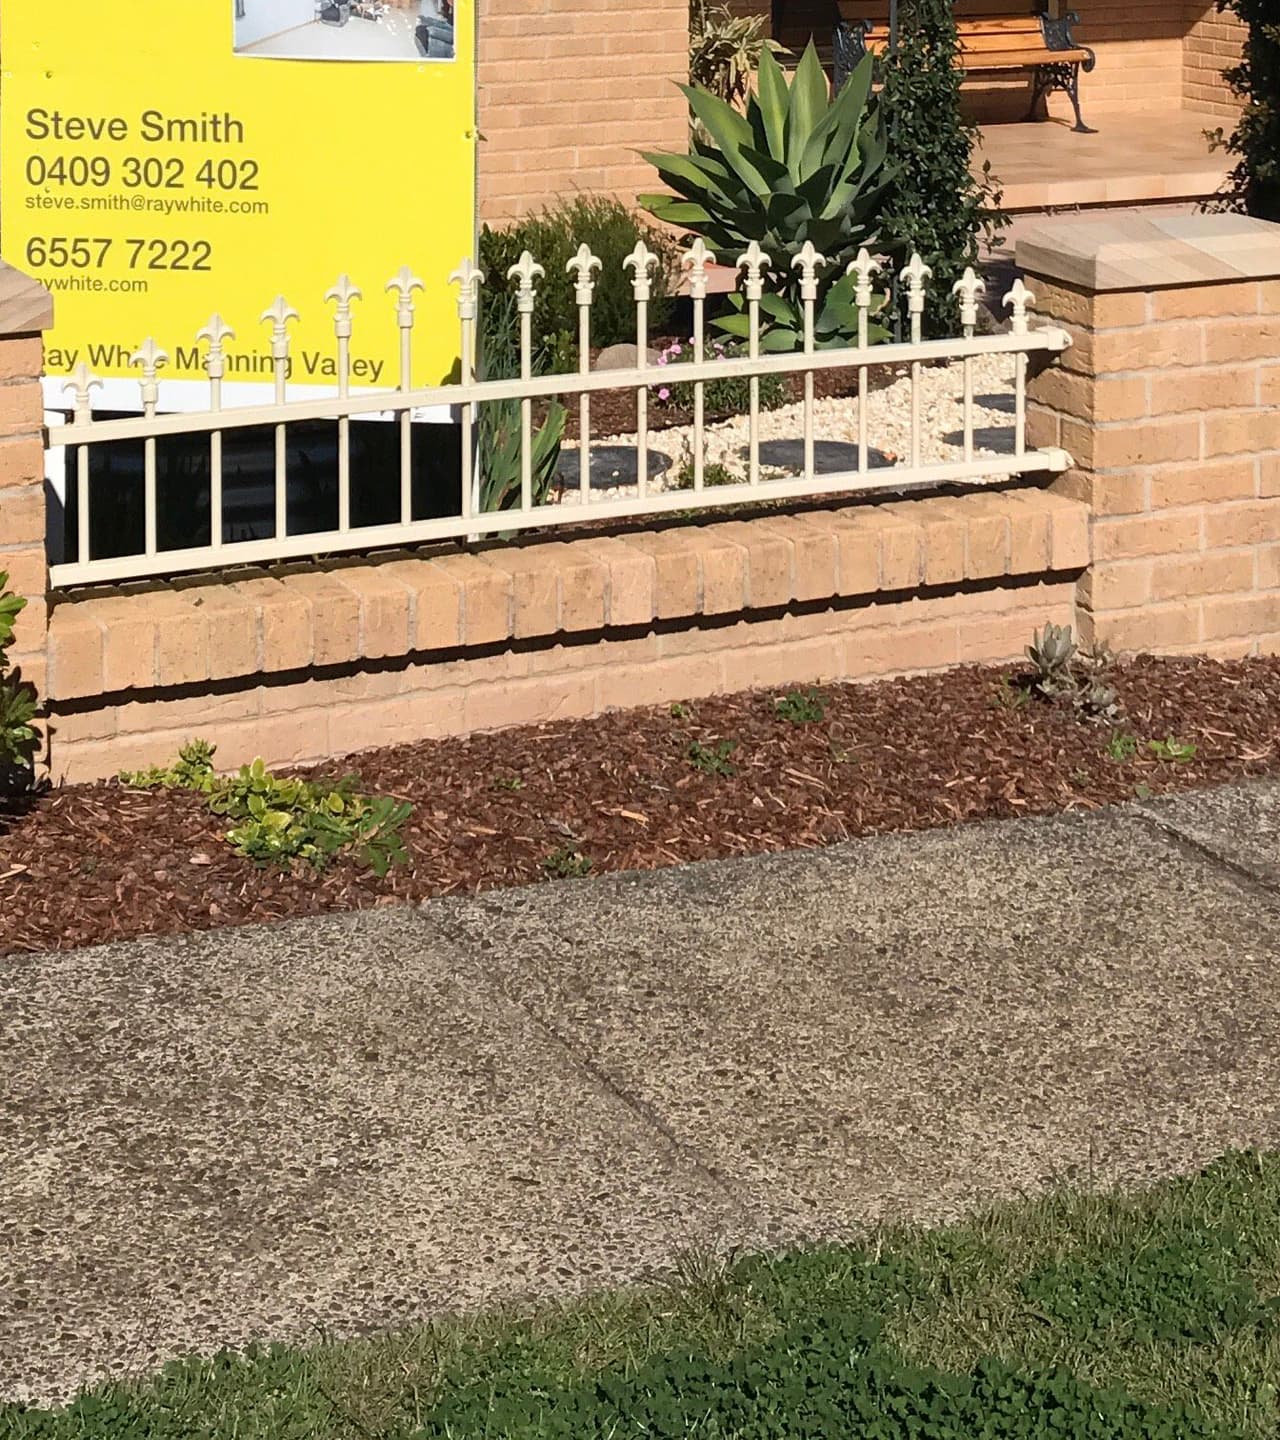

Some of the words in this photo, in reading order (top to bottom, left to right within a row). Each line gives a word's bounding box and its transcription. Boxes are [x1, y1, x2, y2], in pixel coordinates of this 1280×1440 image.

[24, 108, 128, 142] Steve
[140, 110, 245, 144] Smith
[24, 155, 110, 187] 0409
[121, 157, 185, 189] 302
[195, 158, 260, 191] 402
[24, 194, 270, 216] steve.smith@raywhite.com
[25, 237, 113, 269] 6557
[126, 239, 213, 271] 7222
[34, 274, 149, 293] ywhite.com
[41, 345, 79, 373] ay
[87, 344, 169, 369] Whie
[302, 351, 385, 383] Valey
